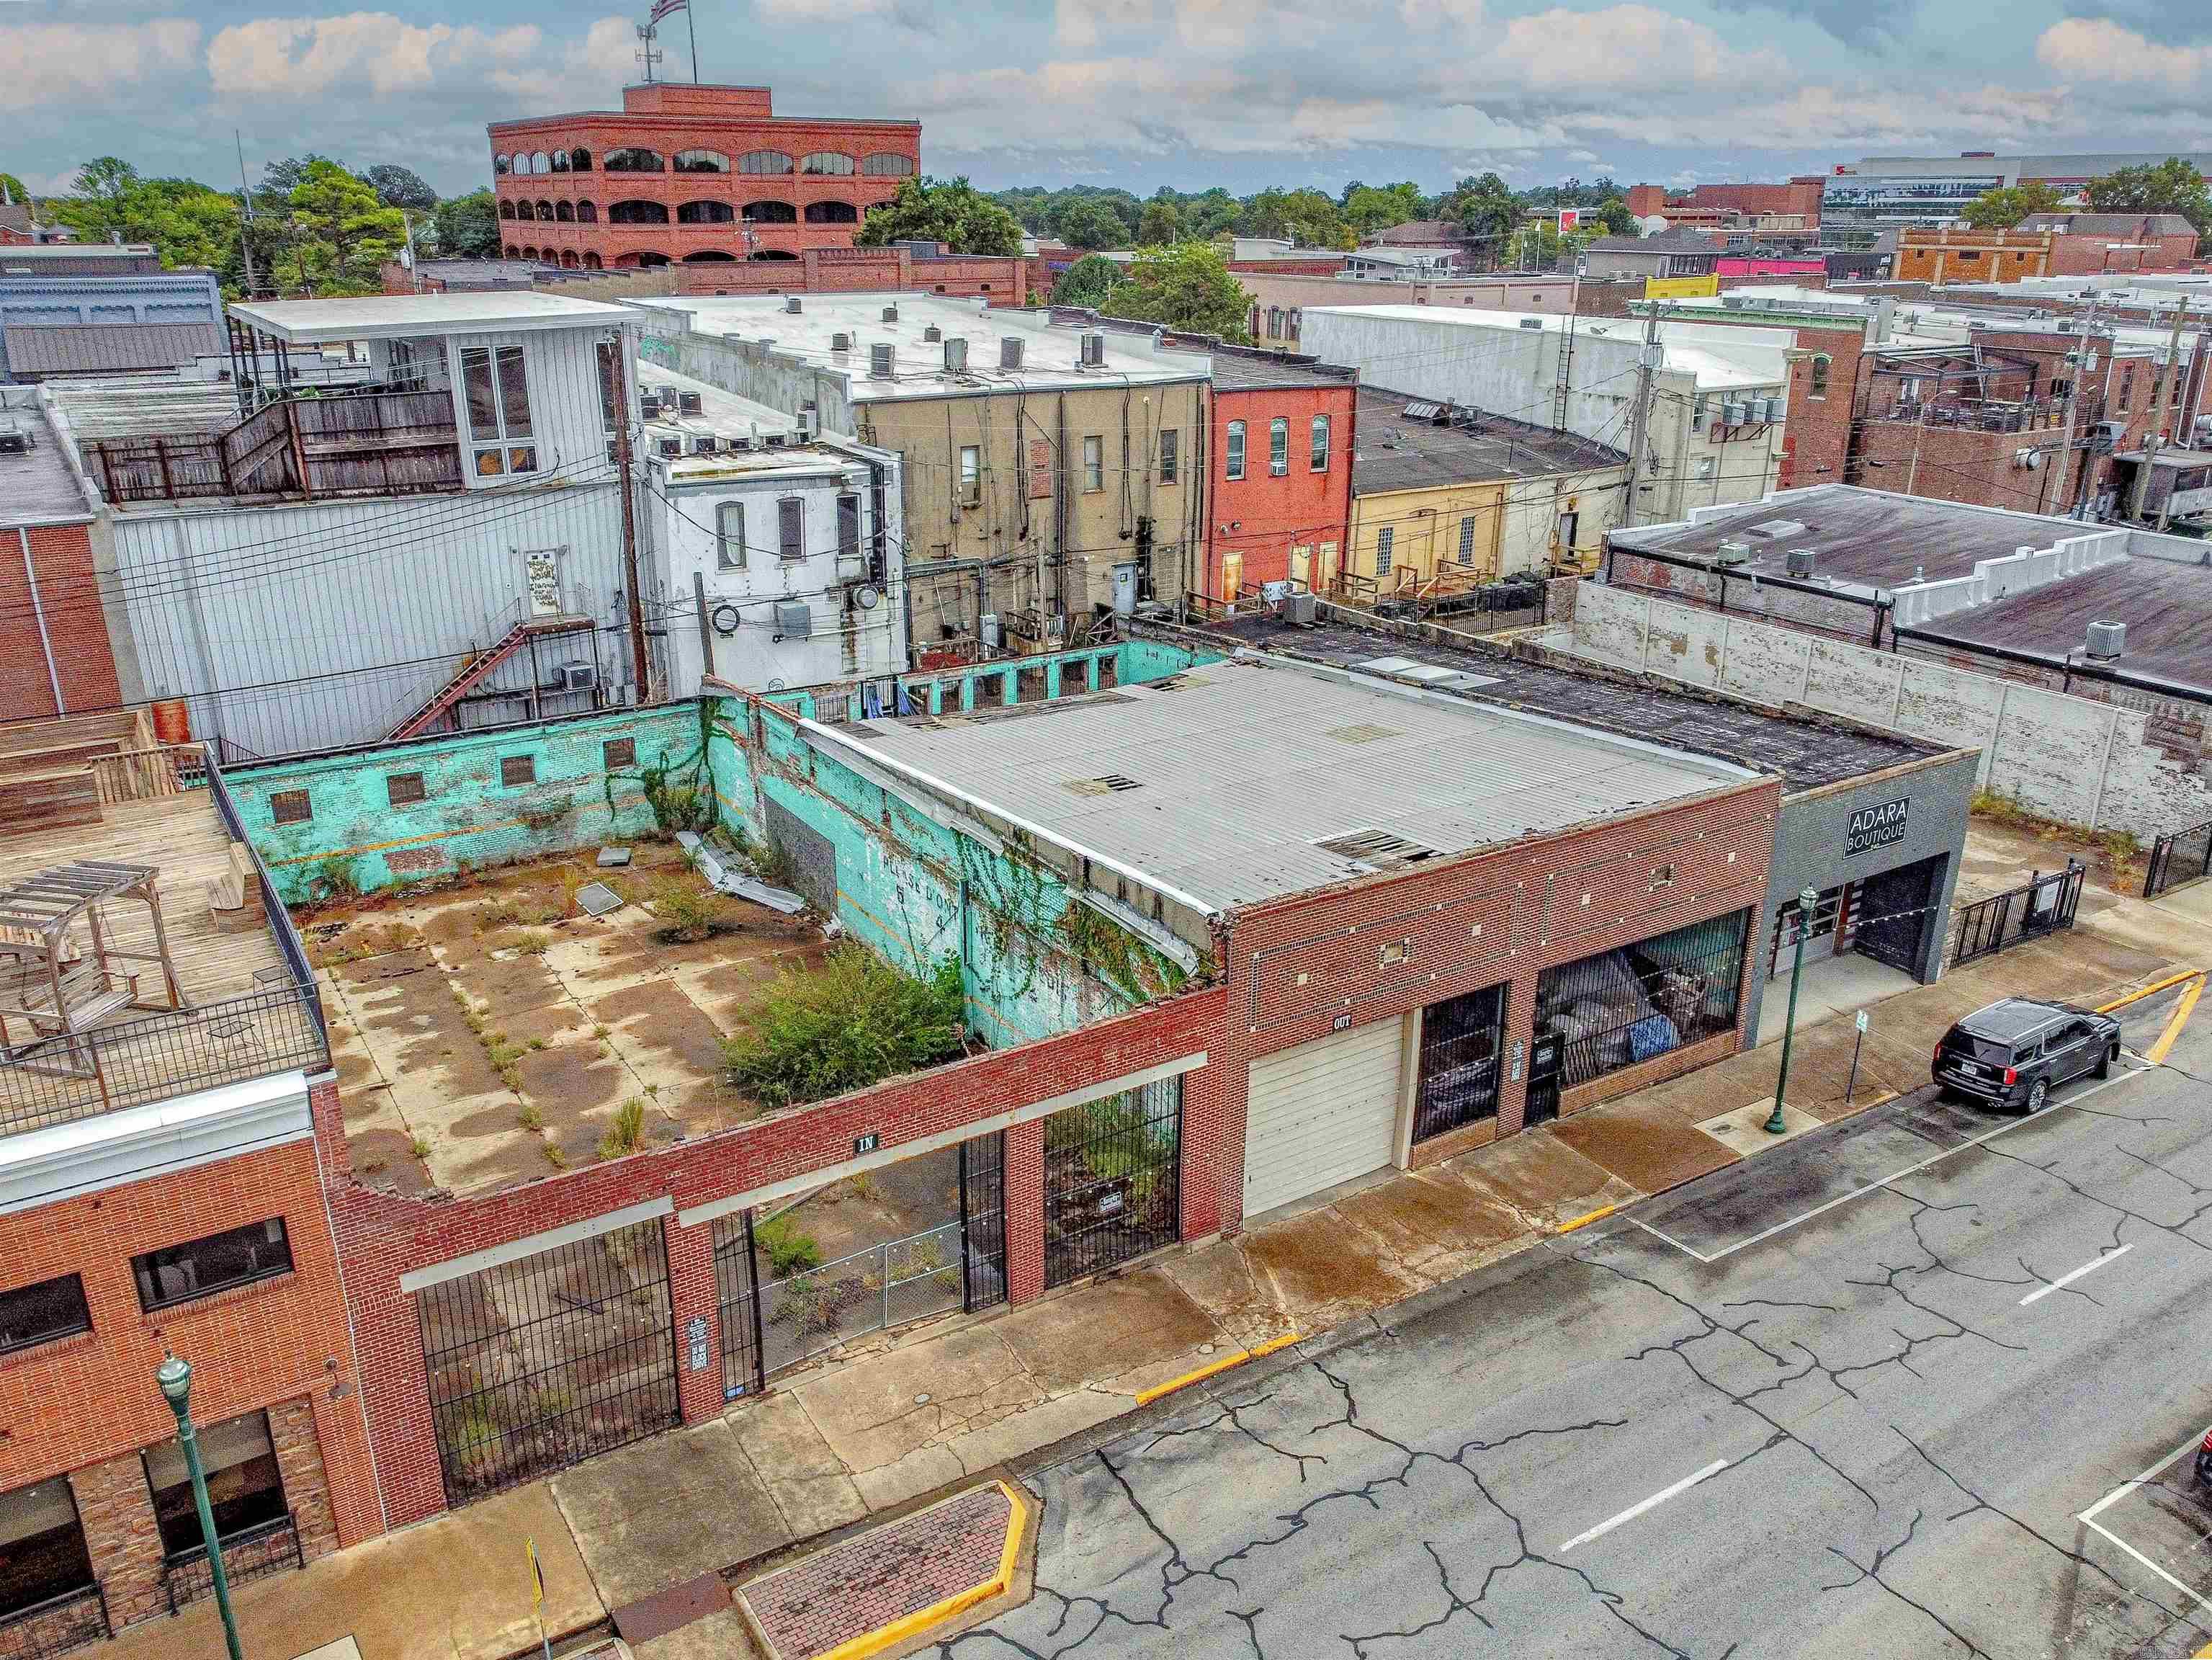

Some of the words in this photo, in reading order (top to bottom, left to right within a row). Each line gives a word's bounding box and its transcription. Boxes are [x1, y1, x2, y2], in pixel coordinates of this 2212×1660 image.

[1850, 800, 1907, 834] ADARA
[1847, 822, 1906, 851] BOUTIQUE
[1334, 1014, 1351, 1030] OUT
[859, 1135, 874, 1152] IN
[692, 1347, 698, 1355] DO
[692, 1352, 707, 1362] BLOCK
[692, 1360, 708, 1370] DRIVE
